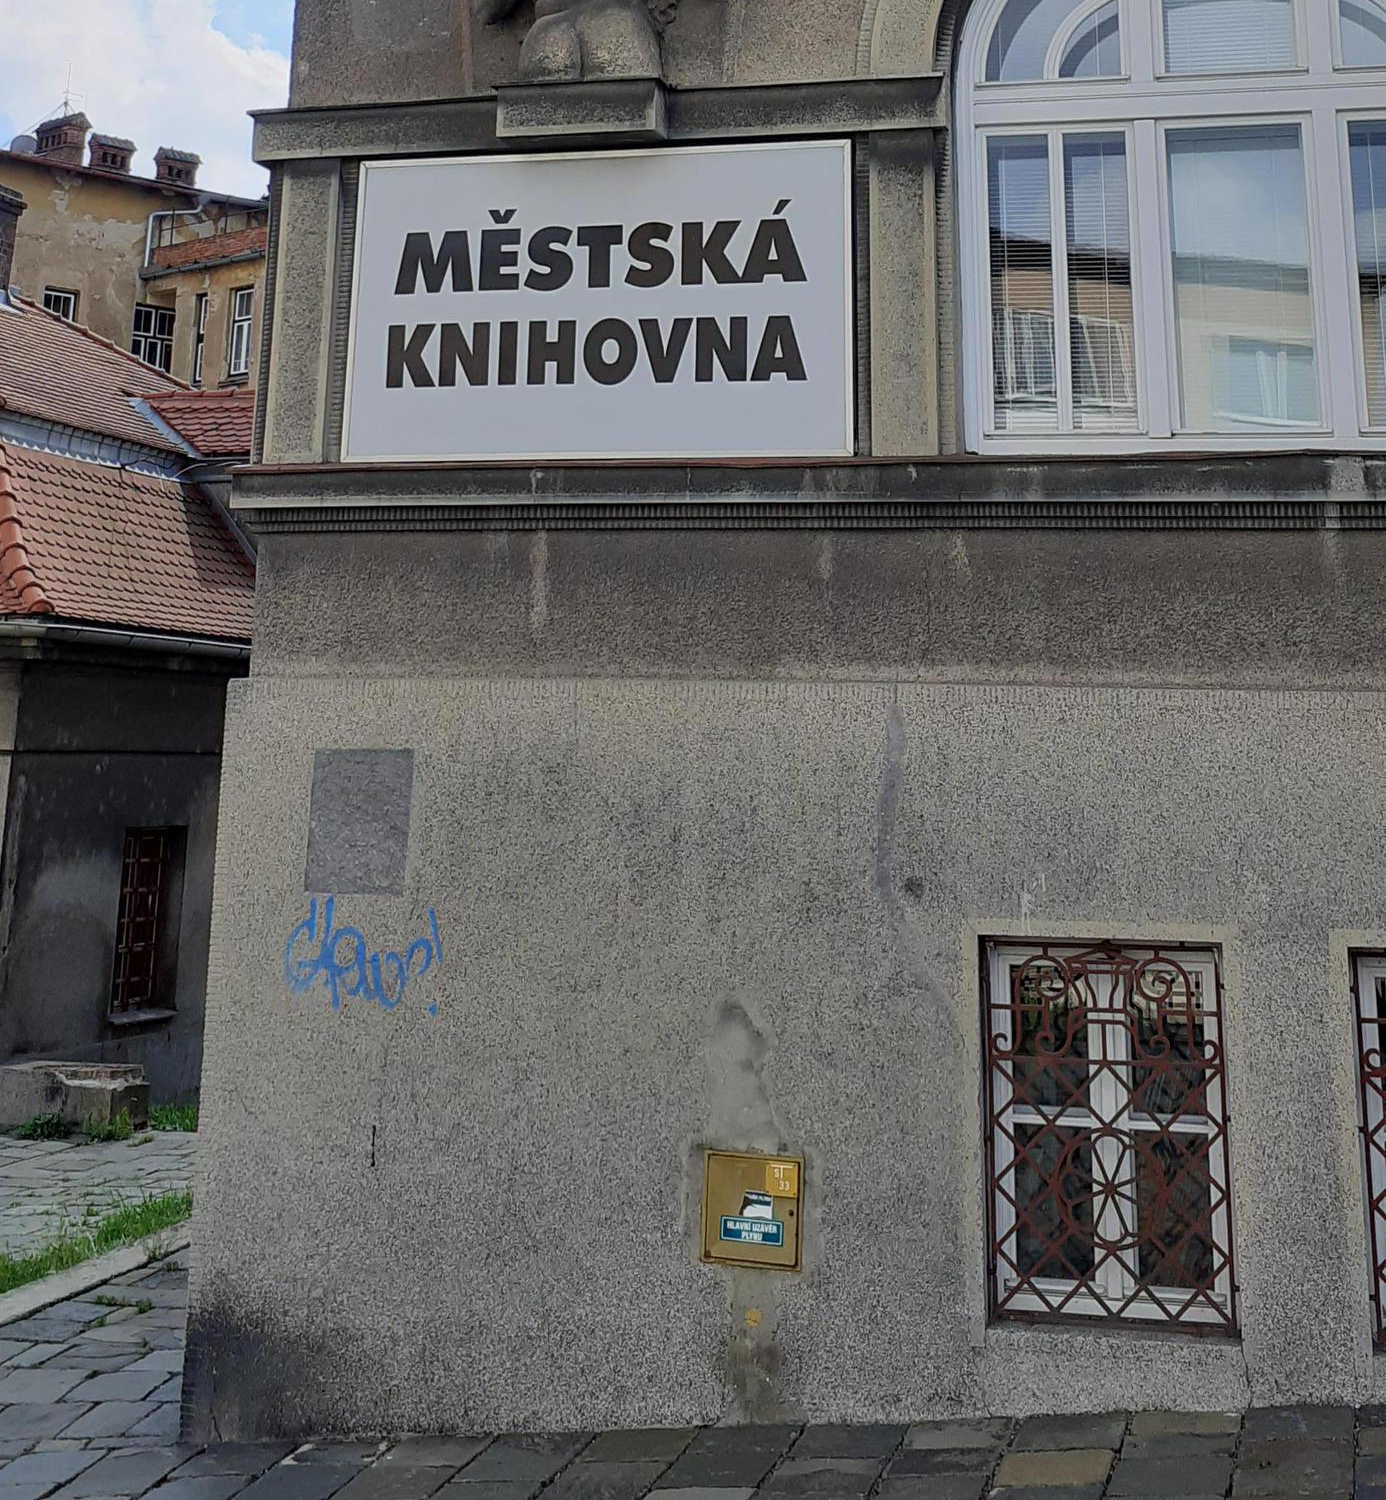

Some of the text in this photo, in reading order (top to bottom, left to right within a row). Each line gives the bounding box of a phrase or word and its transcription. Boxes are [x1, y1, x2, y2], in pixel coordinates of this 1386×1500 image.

[394, 198, 808, 296] MĚSTSKÁ
[385, 314, 808, 389] KNIHOVNA
[741, 1230, 762, 1241] PLYNU
